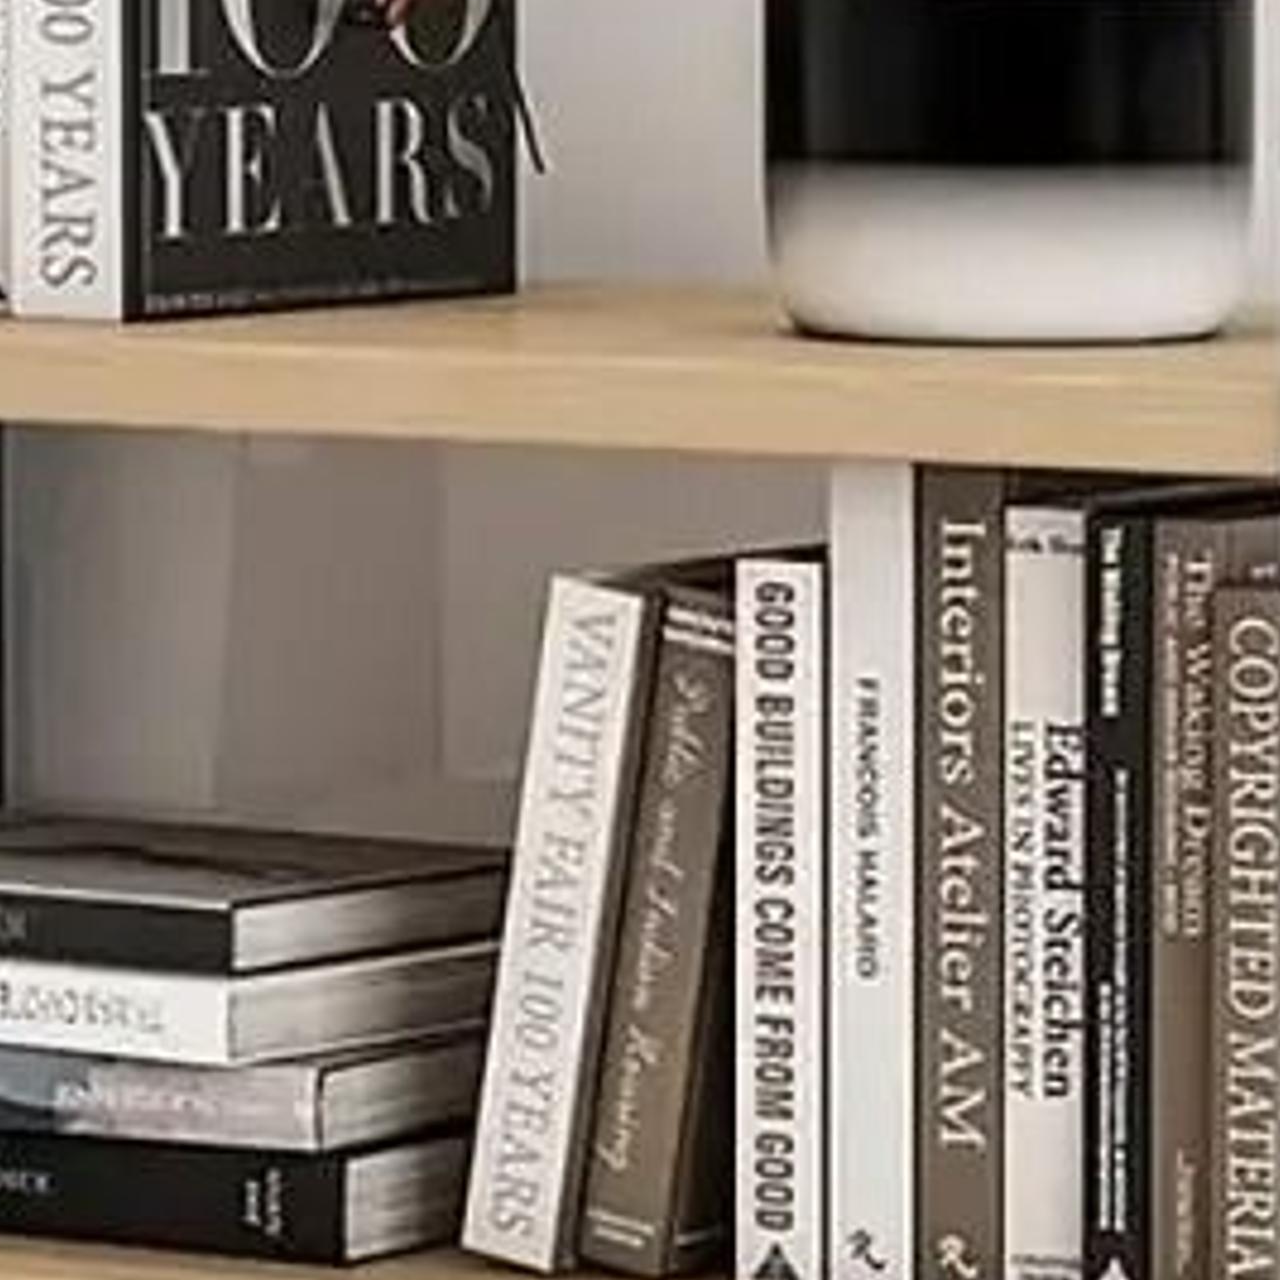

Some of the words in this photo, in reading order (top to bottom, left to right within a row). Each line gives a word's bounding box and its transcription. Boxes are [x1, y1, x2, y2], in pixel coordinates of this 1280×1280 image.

[39, 71, 99, 289] YEARS
[142, 92, 496, 240] YEARS
[754, 581, 796, 680] GOOD
[940, 520, 987, 783] Interiors
[548, 614, 618, 819] VANITY
[754, 695, 796, 887] BUILDINGS
[523, 830, 588, 952] FAIR
[1043, 722, 1085, 892] Edward
[1228, 618, 1279, 1018] COPYRIGHTED
[754, 898, 796, 1004] COME
[940, 798, 990, 1012] Atelier
[754, 1015, 796, 1120] FROM
[1043, 907, 1083, 1098] Steichen
[489, 1070, 554, 1236] YEARS
[940, 1027, 987, 1149] AM
[754, 1131, 795, 1232] GOOD
